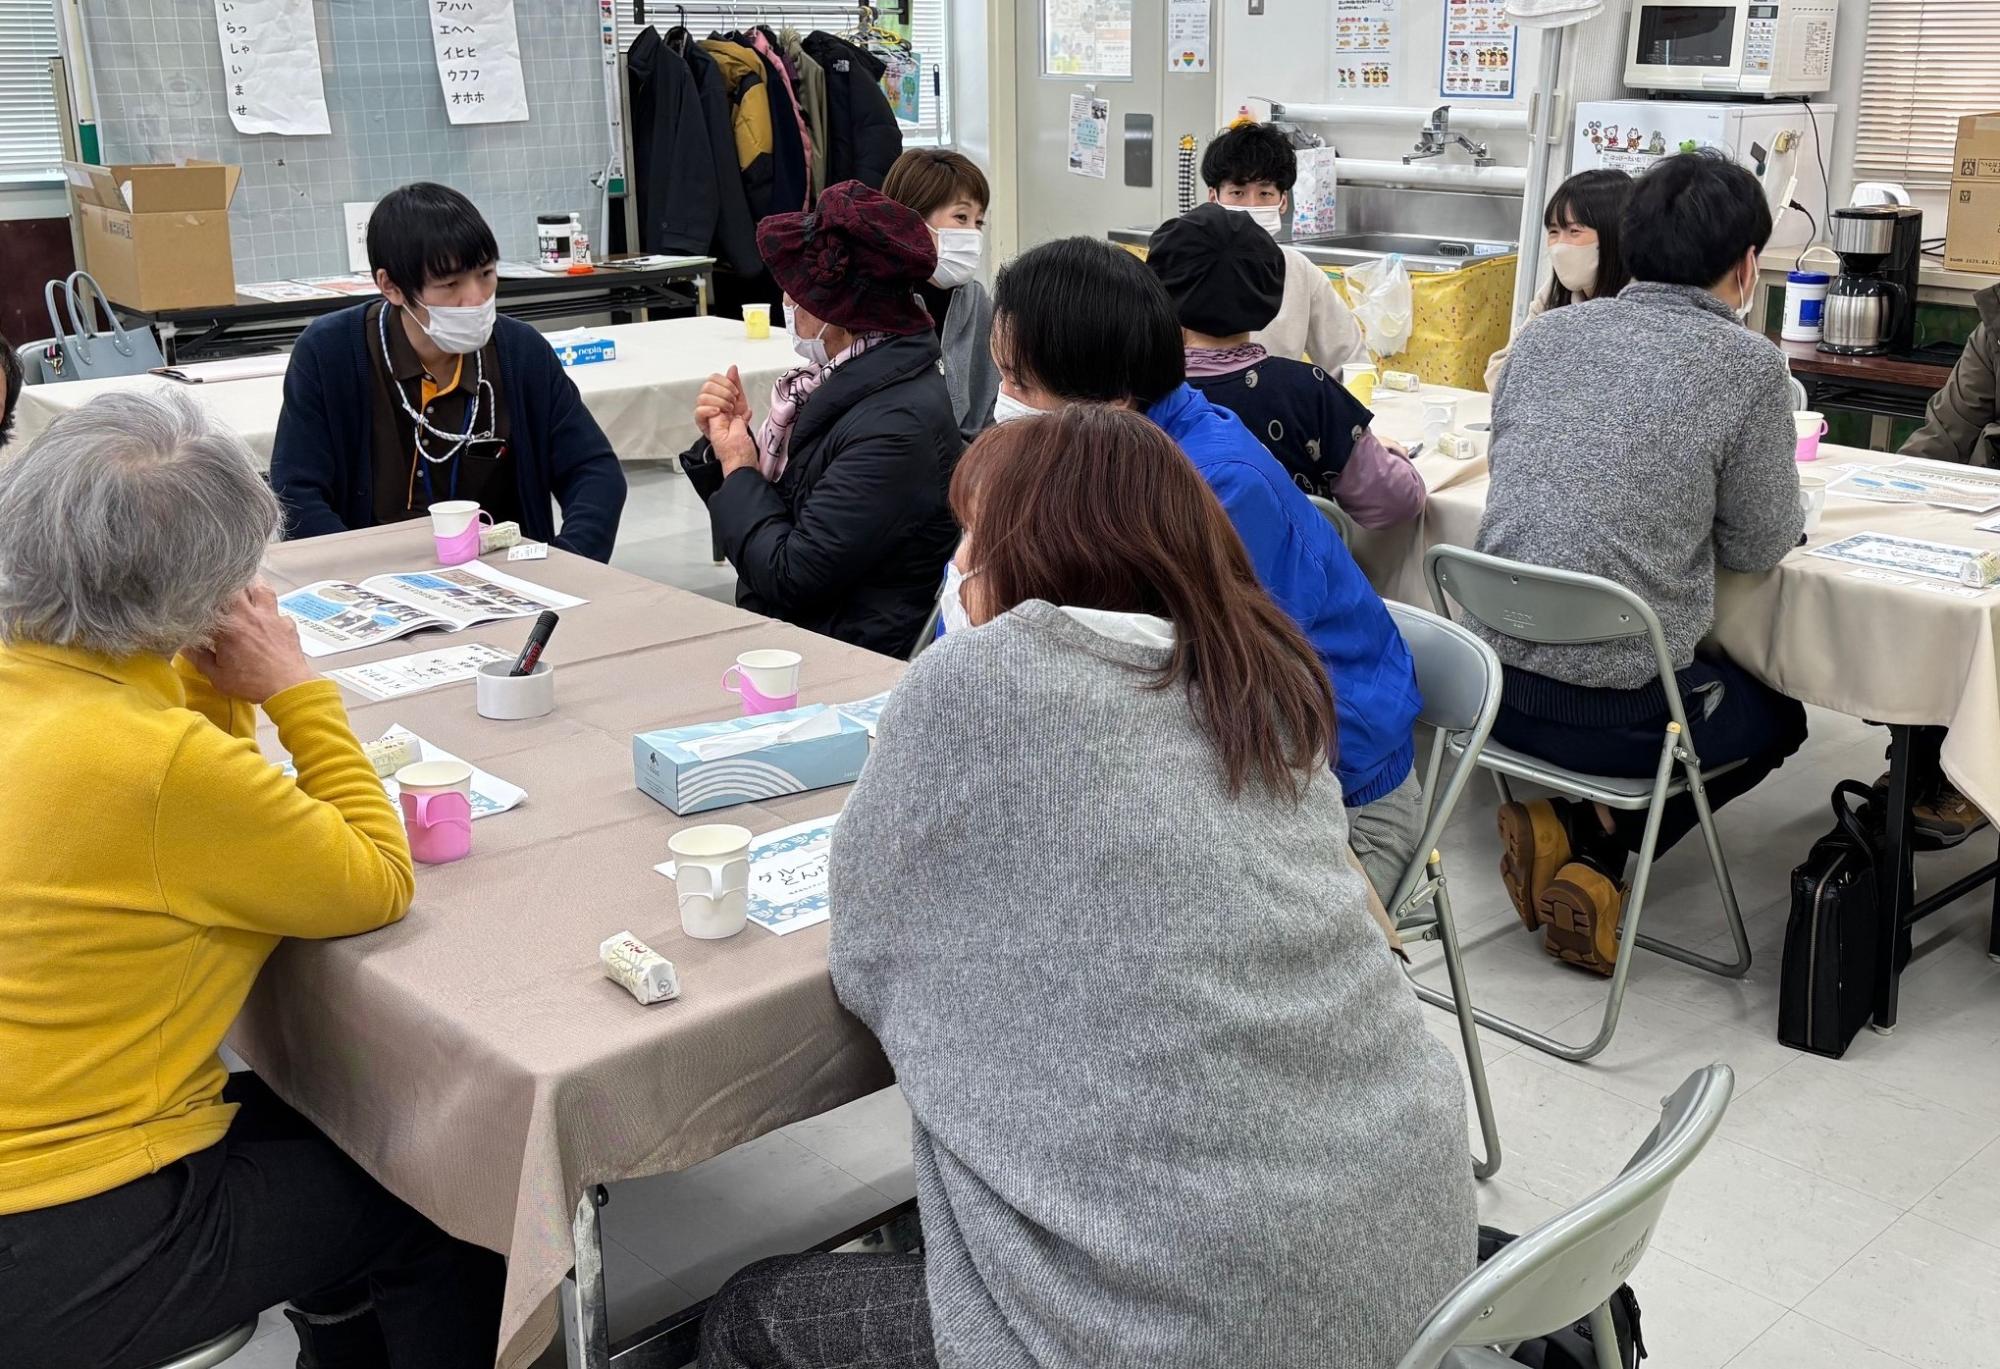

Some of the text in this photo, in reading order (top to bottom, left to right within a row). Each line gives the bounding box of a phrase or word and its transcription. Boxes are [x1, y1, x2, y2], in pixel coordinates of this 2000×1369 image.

[436, 1, 473, 13] アハハ
[439, 25, 475, 35] エヘヘ
[443, 46, 477, 60] イヒヒ
[447, 69, 480, 82] ウフフ
[451, 91, 485, 105] オホホ
[578, 344, 602, 356] nepia
